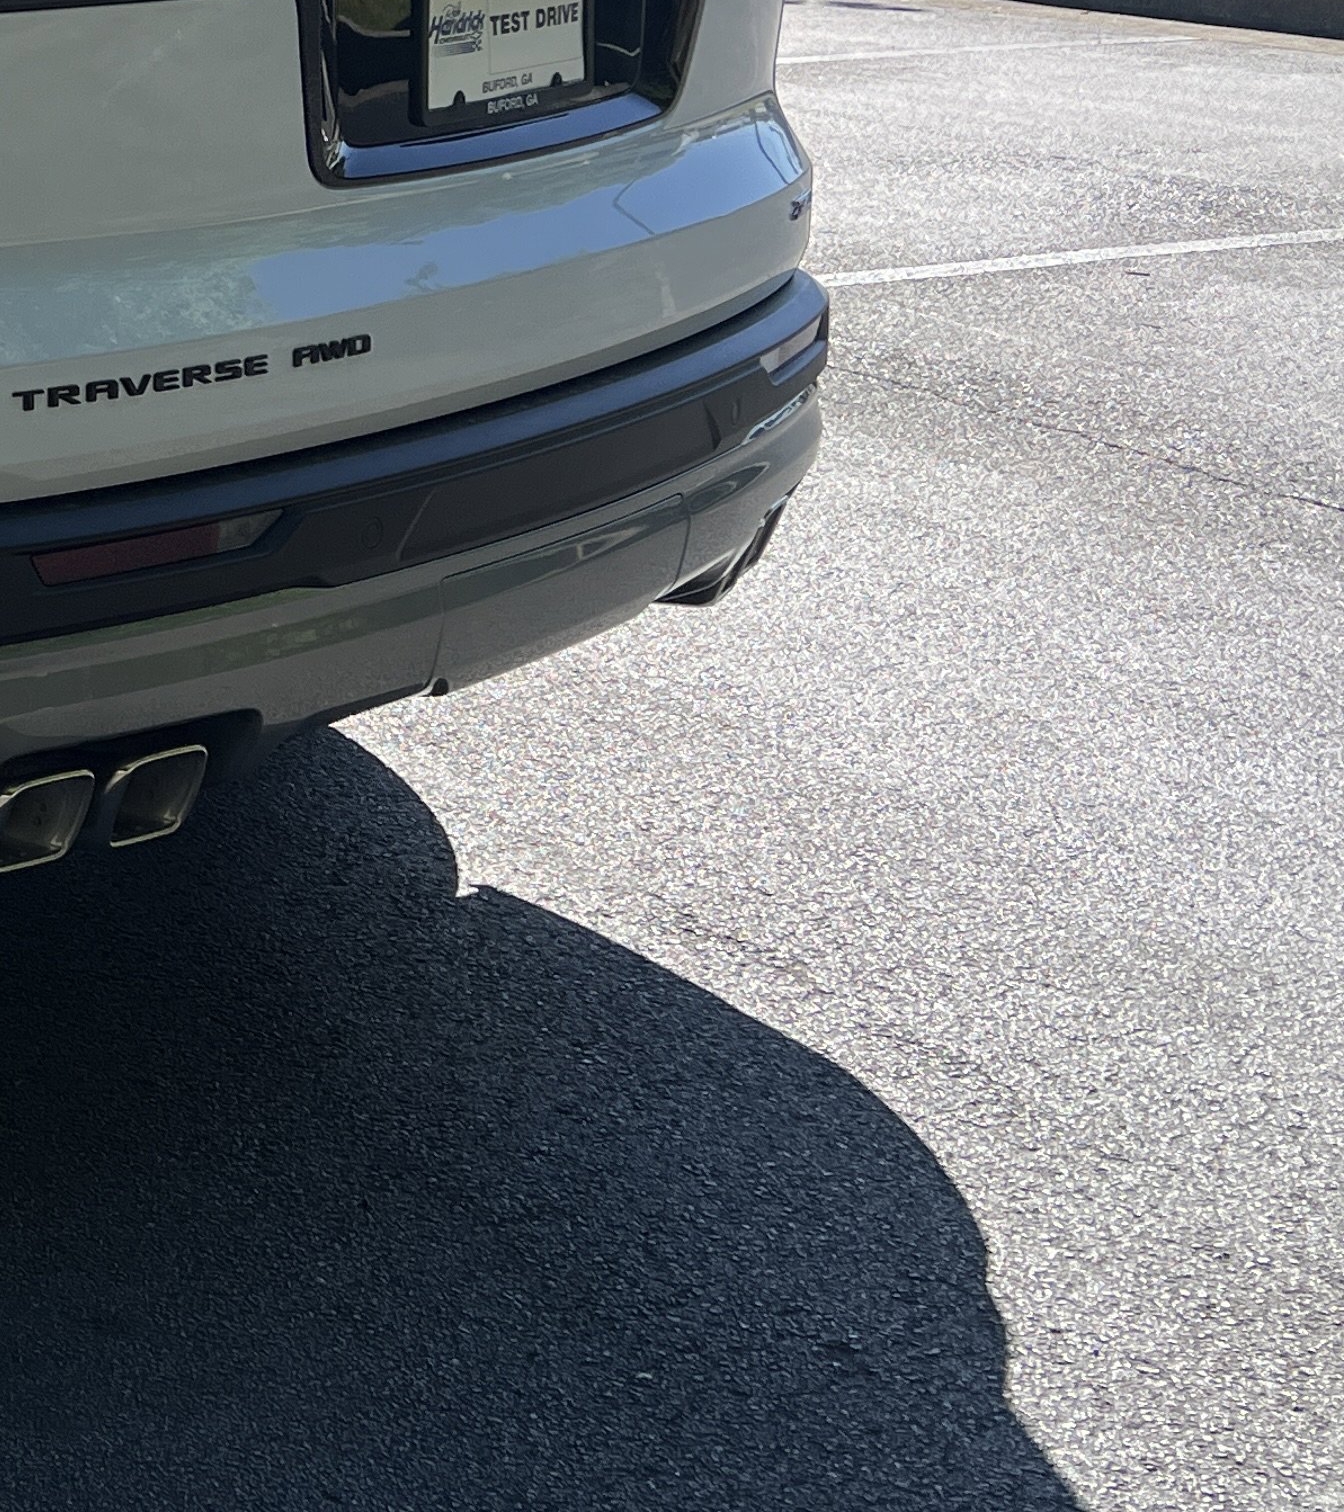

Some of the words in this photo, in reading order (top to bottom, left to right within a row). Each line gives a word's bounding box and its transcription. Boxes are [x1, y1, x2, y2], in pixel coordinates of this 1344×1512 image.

[489, 10, 530, 36] TEST
[535, 2, 579, 29] DRIVE
[521, 72, 533, 85] GA
[526, 93, 538, 106] GA
[12, 354, 269, 412] TRAVERSE
[291, 334, 372, 368] AWD
